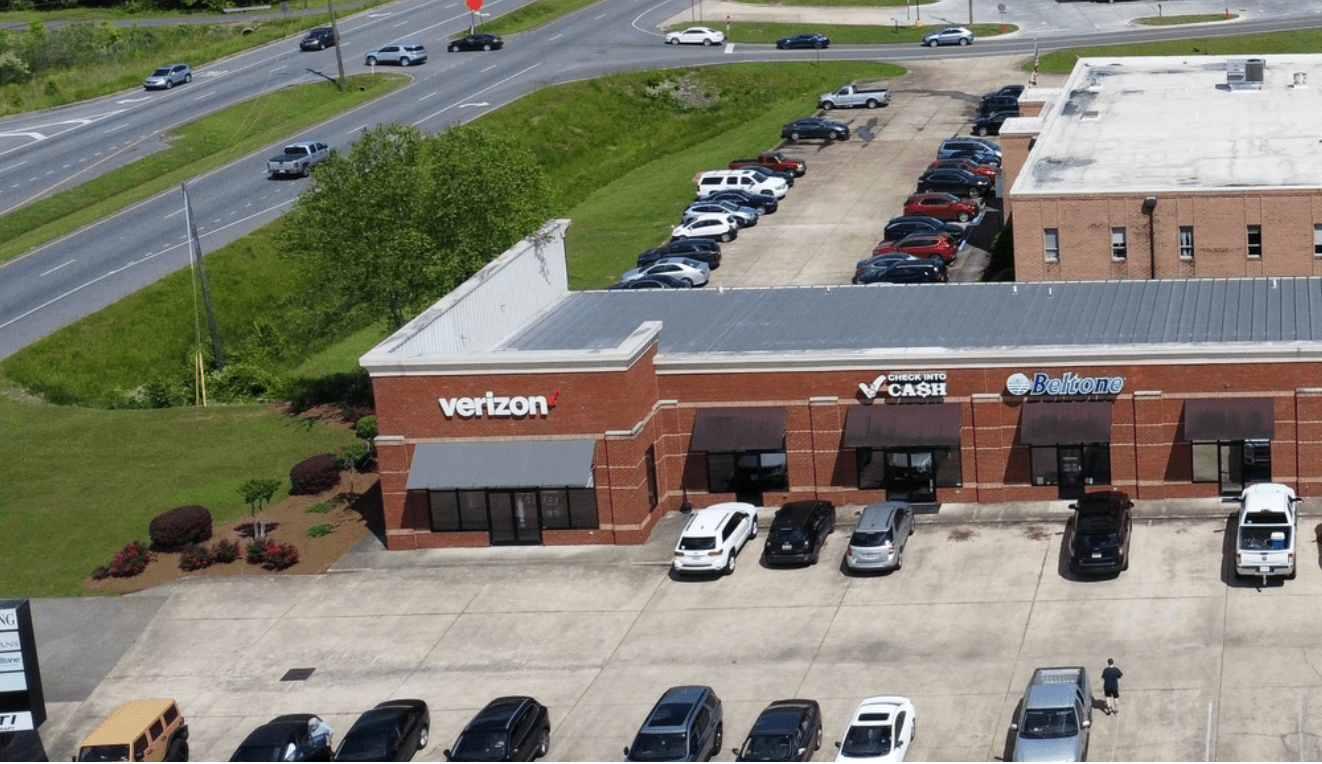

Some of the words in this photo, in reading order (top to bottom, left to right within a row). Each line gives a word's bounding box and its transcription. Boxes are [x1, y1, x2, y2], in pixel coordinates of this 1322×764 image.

[888, 373, 922, 381] CHECK
[923, 372, 947, 381] INTO
[1031, 372, 1124, 395] Beltone
[887, 380, 948, 398] CA$H
[438, 391, 549, 416] verizon
